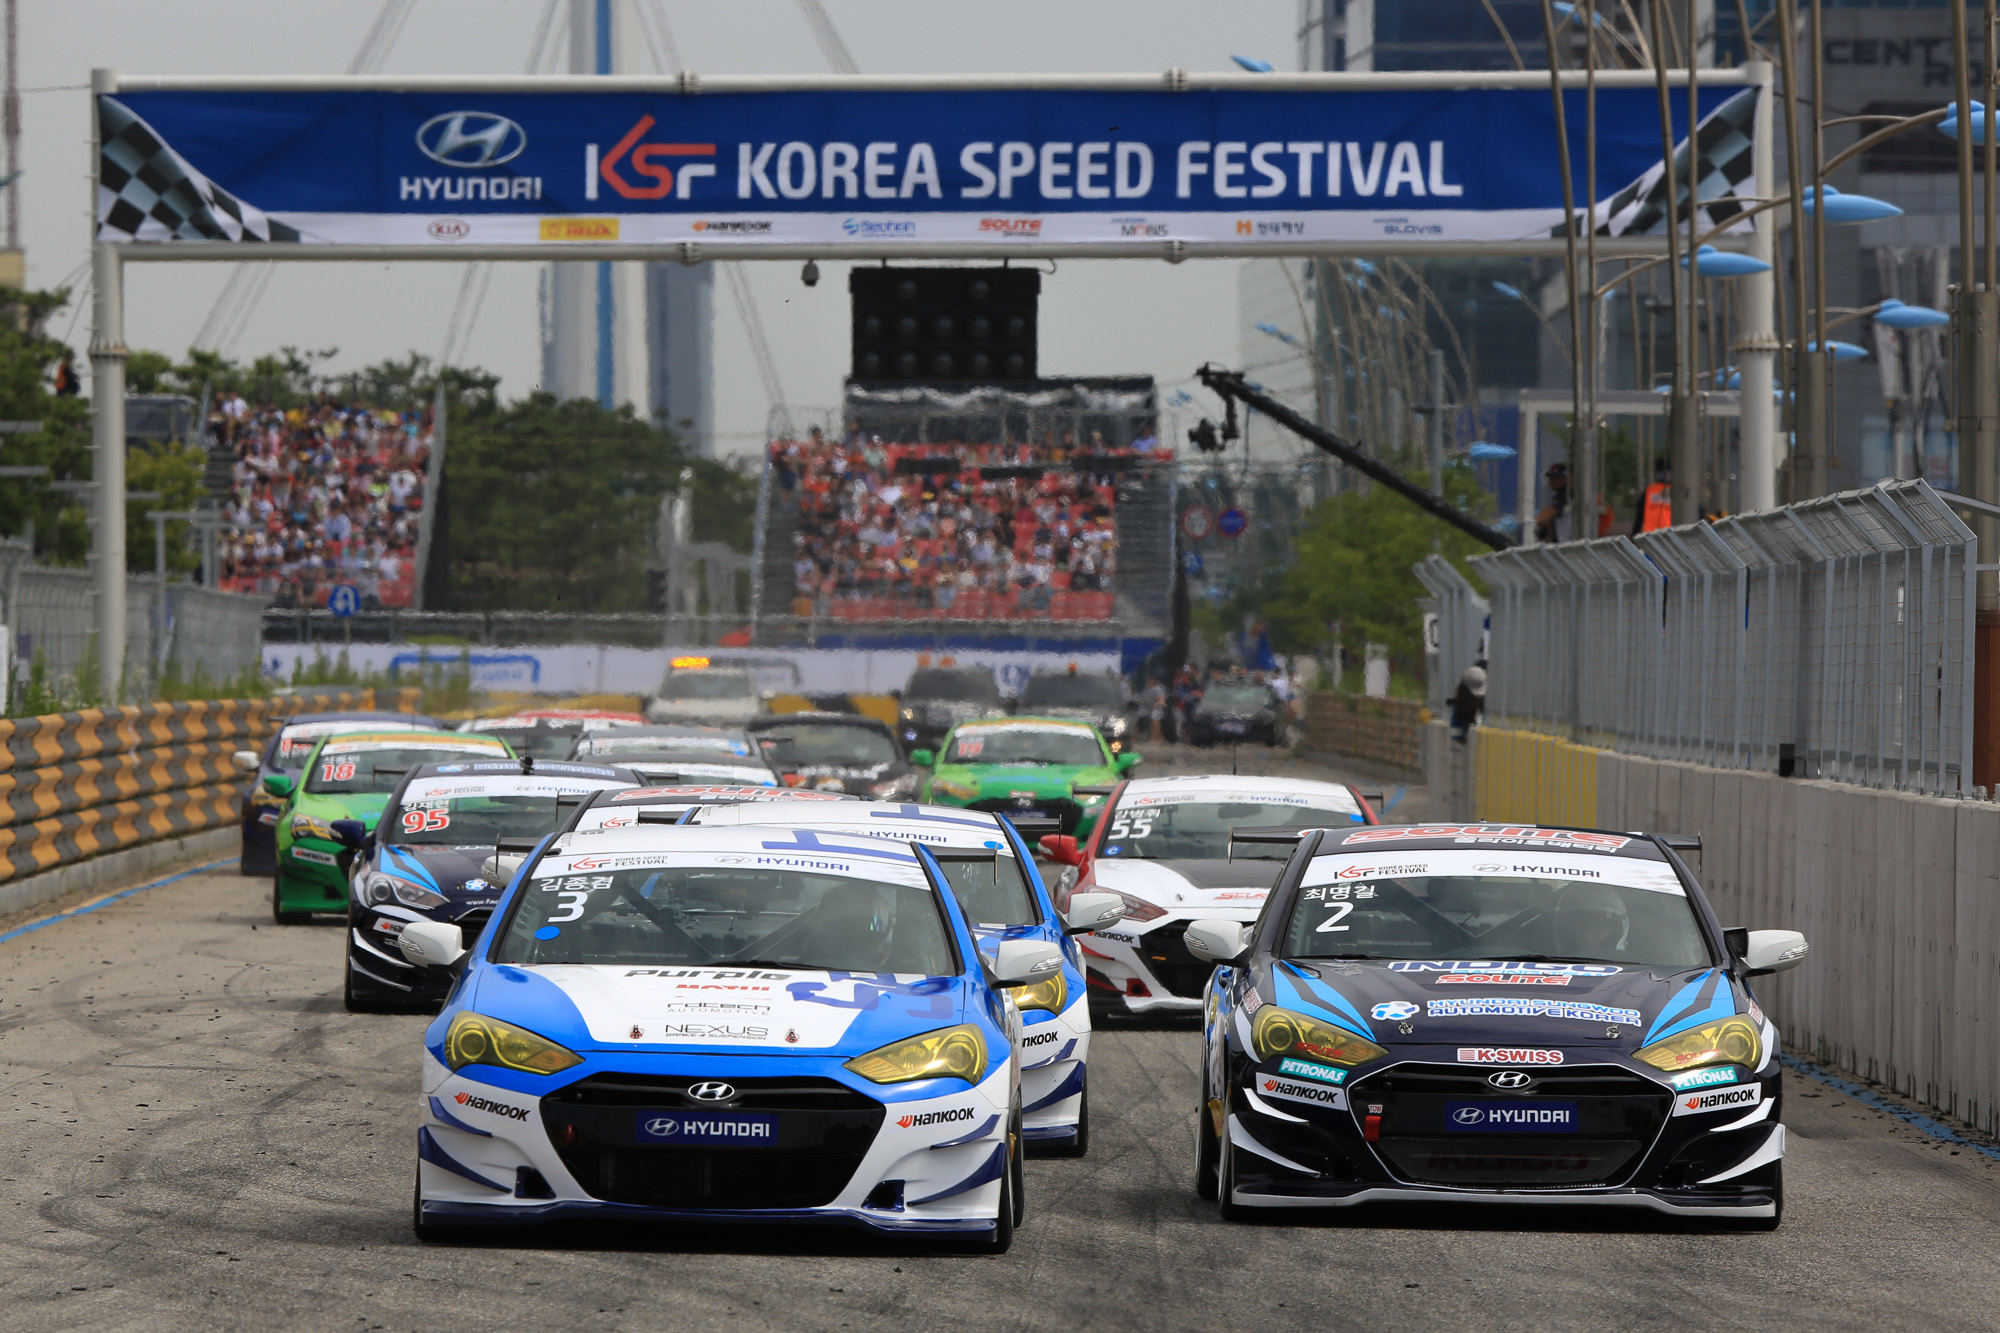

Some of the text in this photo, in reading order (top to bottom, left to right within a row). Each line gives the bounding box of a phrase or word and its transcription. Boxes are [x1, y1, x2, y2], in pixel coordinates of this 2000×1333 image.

[738, 142, 942, 200] KOREA
[960, 142, 1154, 199] SPEED
[1177, 141, 1463, 199] FESTIVAL
[400, 177, 542, 200] HYUNDAI
[321, 762, 355, 782] 18
[402, 808, 451, 834] 95
[1108, 818, 1153, 840] 55
[869, 831, 947, 843] HYUNDAI
[1341, 826, 1632, 849] SOLITE
[615, 859, 668, 867] FESTIVAL
[757, 857, 850, 871] HYUNDAI
[1378, 868, 1429, 876] FESTIVAL
[1513, 865, 1601, 878] HYUNDAI
[1303, 884, 1376, 900] 최명길
[547, 891, 589, 923] 3
[1315, 902, 1354, 933] 2
[623, 969, 794, 981] purple
[1387, 962, 1624, 976] INDIGO
[1435, 974, 1573, 987] SOLITE
[667, 1008, 770, 1016] AUTOMOTIVE
[1427, 998, 1641, 1018] HYUNDAI SUNGWOO
[1427, 1006, 1642, 1027] AUTOMOTIVE KOREA
[665, 1024, 769, 1036] NEXUS
[1280, 1060, 1345, 1082] PETRONAS
[1674, 1069, 1735, 1088] PETRONAS
[1368, 1105, 1383, 1113] TOW
[1489, 1109, 1570, 1123] HYUNDAI
[684, 1121, 770, 1137] HYUNDAI
